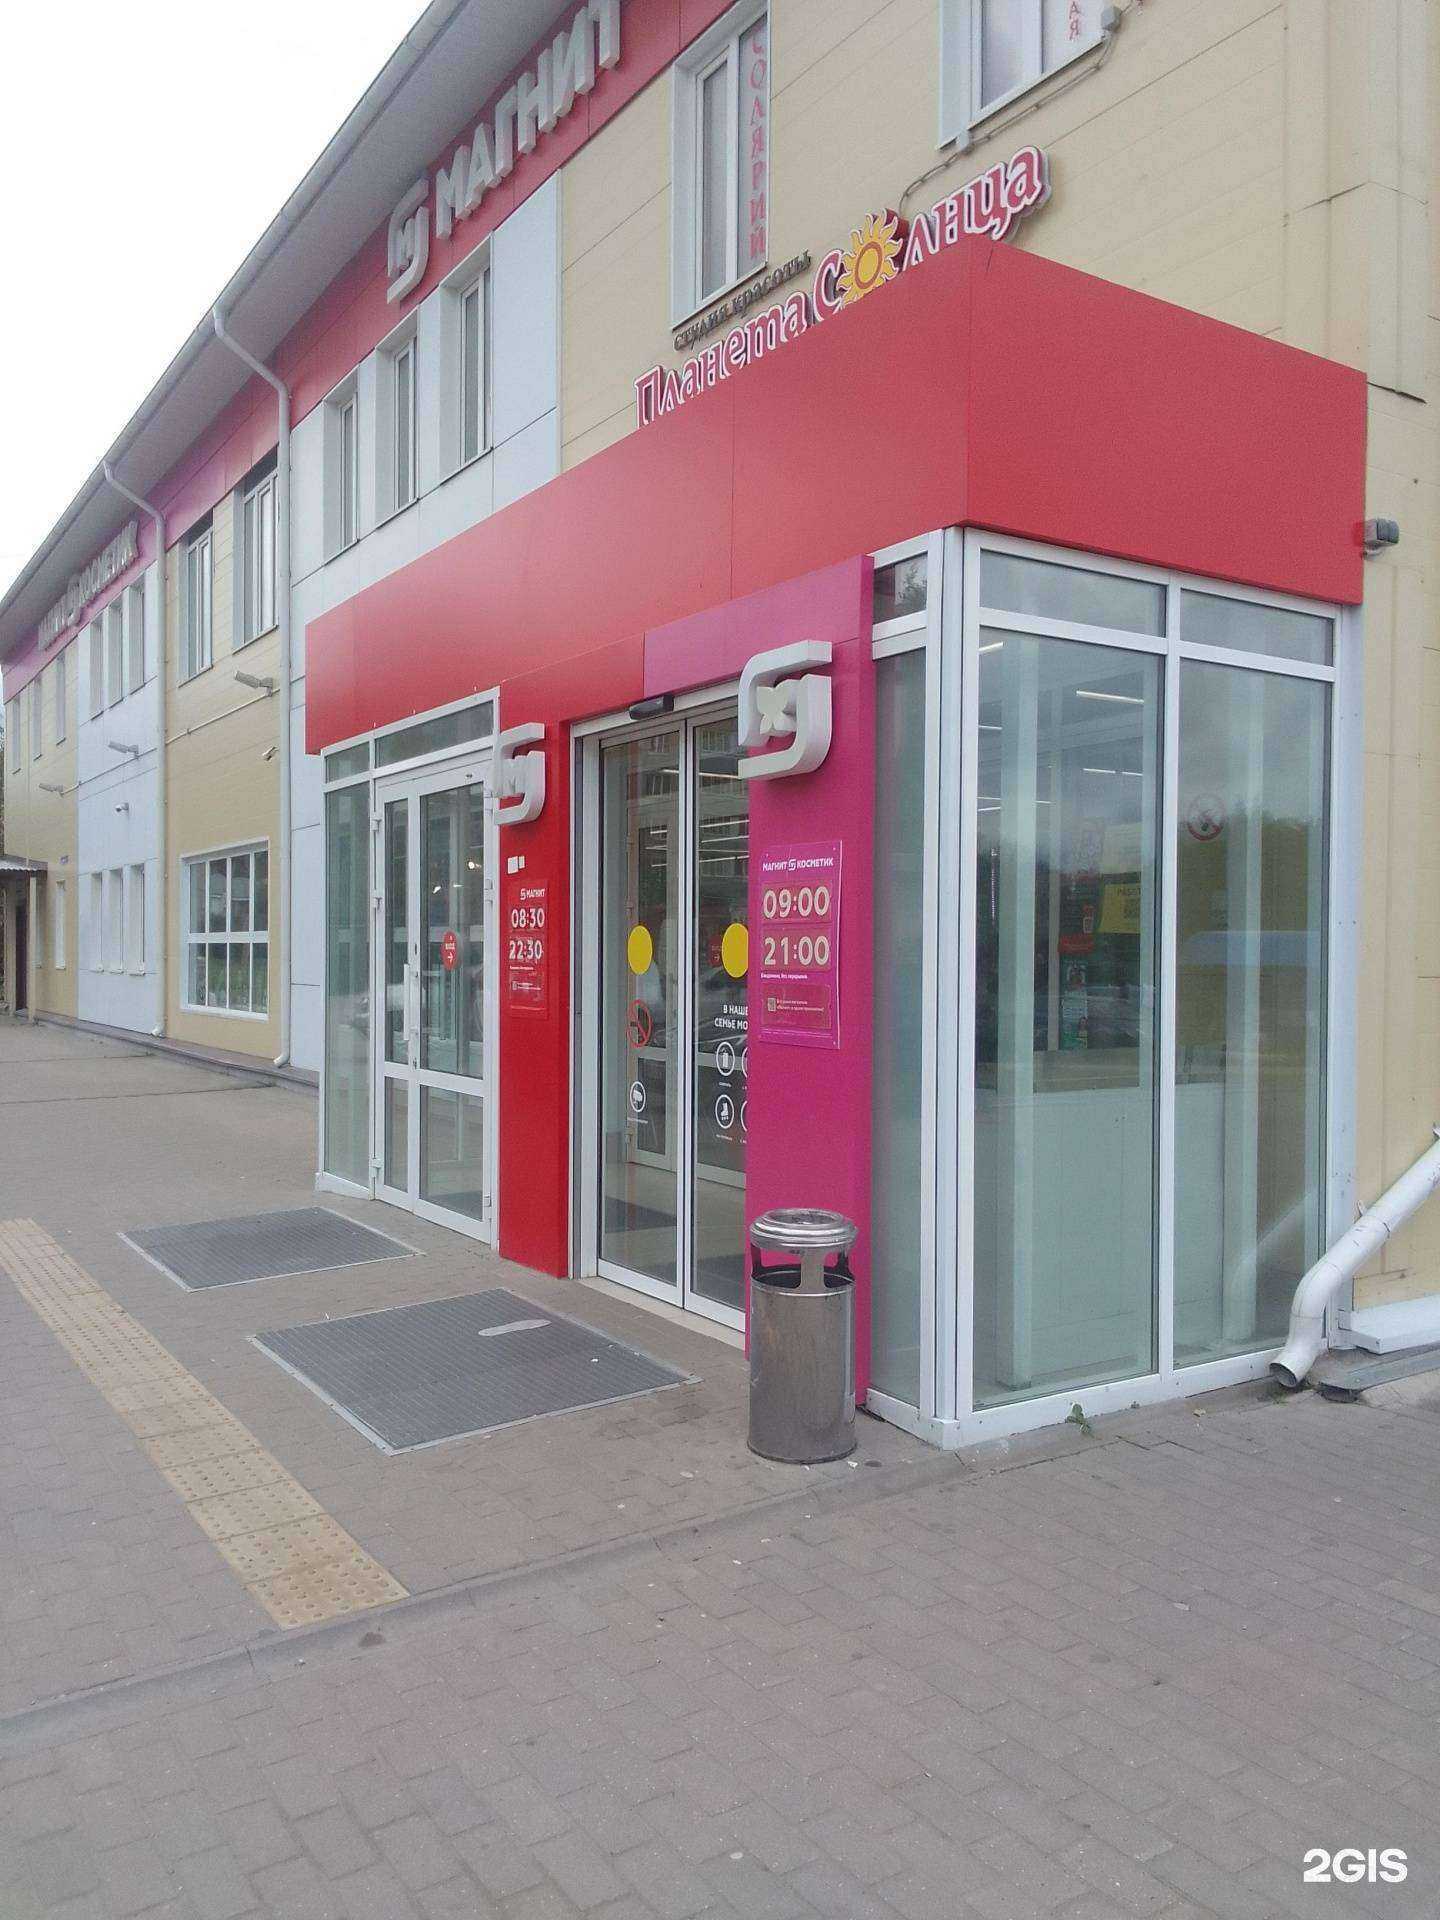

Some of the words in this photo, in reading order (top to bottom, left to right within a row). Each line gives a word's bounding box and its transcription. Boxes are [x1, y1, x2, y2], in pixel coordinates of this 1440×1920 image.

[633, 291, 808, 427] Планета
[762, 861, 789, 872] МАГНИТ
[797, 857, 835, 870] КОСМЕТИК
[763, 886, 830, 919] 09:00
[511, 908, 545, 928] 08:30
[509, 940, 543, 960] 22:30
[764, 936, 830, 967] 21:00
[714, 1017, 736, 1029] СЕМЬЕ
